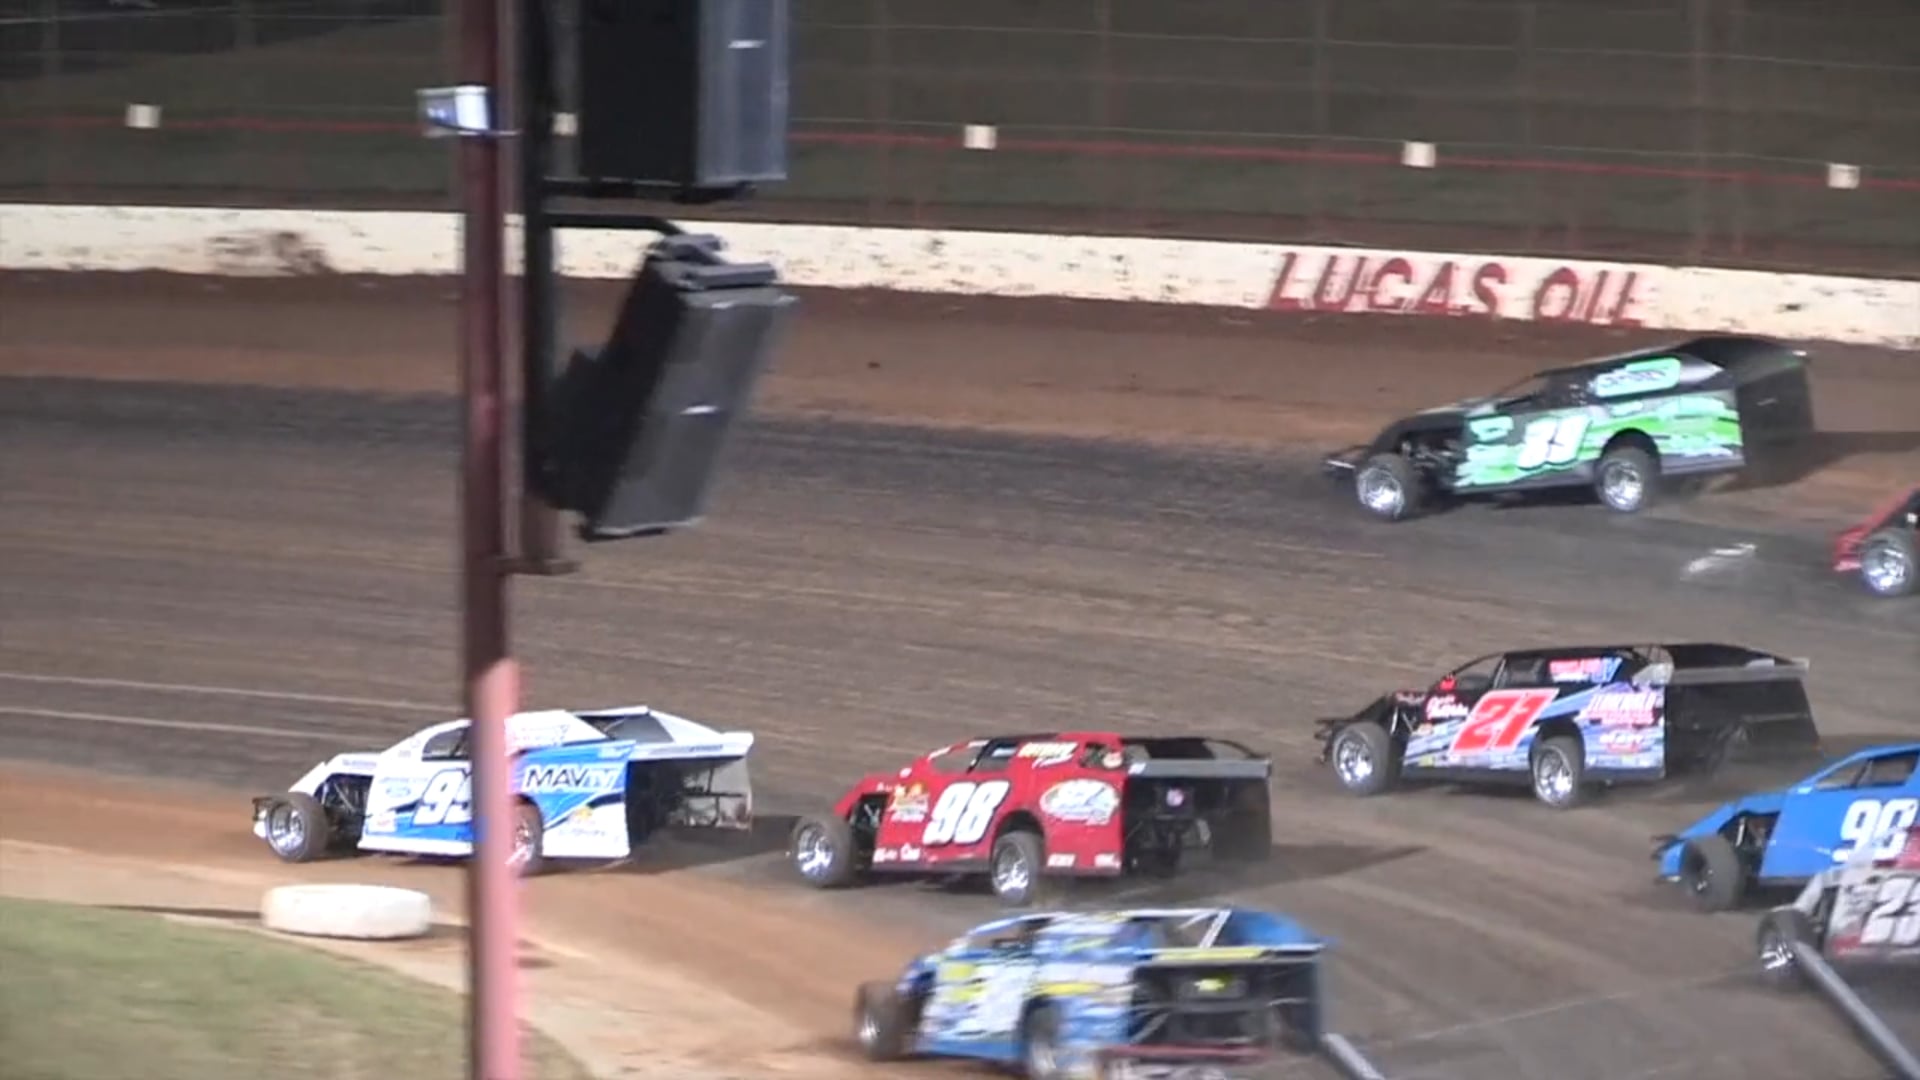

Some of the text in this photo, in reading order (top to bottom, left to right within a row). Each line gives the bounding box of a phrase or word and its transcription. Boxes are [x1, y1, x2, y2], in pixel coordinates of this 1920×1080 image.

[1266, 251, 1642, 328] LUCAS OIL
[1450, 690, 1556, 753] 21
[922, 780, 1010, 846] 98
